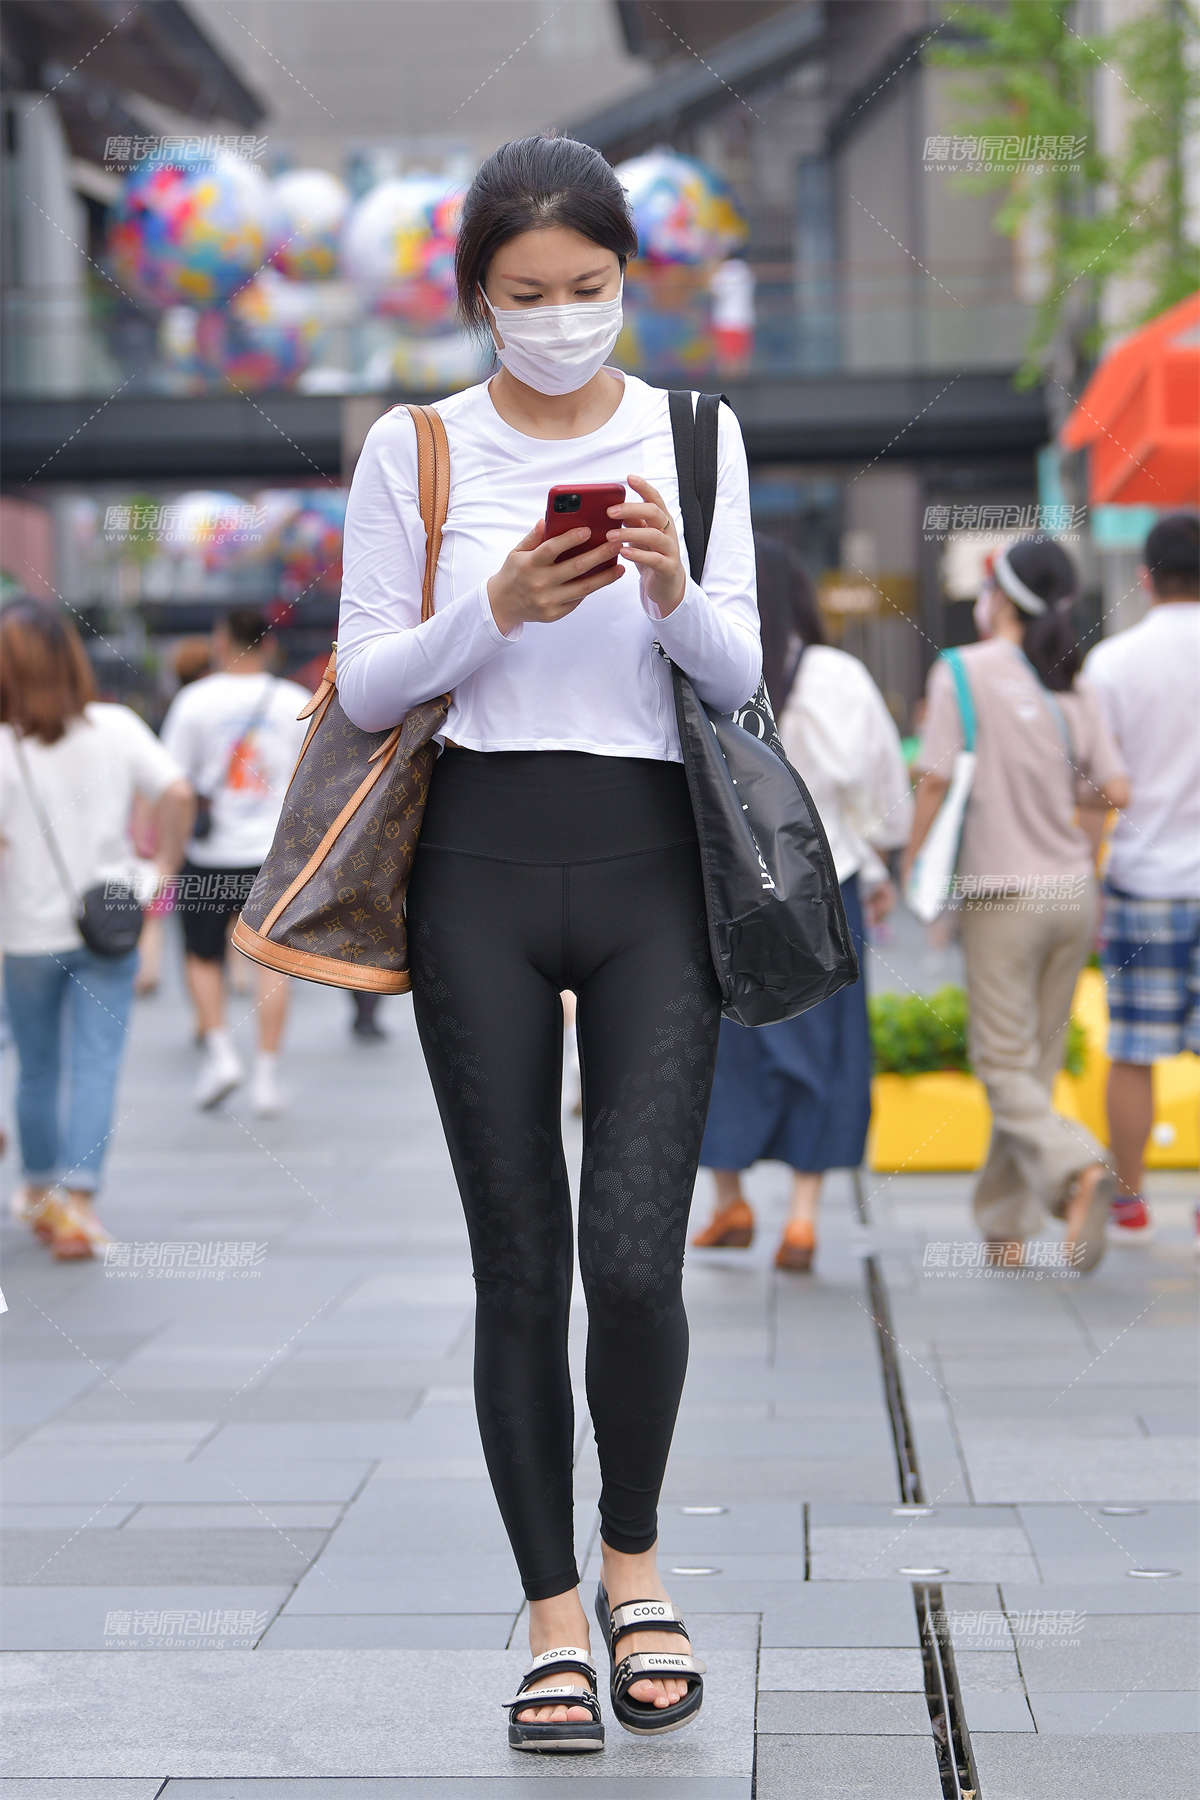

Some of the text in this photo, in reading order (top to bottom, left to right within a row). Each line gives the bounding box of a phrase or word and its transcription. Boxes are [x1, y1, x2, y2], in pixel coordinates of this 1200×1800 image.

[633, 1606, 665, 1617] COCO
[542, 1649, 577, 1661] COCO
[648, 1658, 687, 1666] CHANEL
